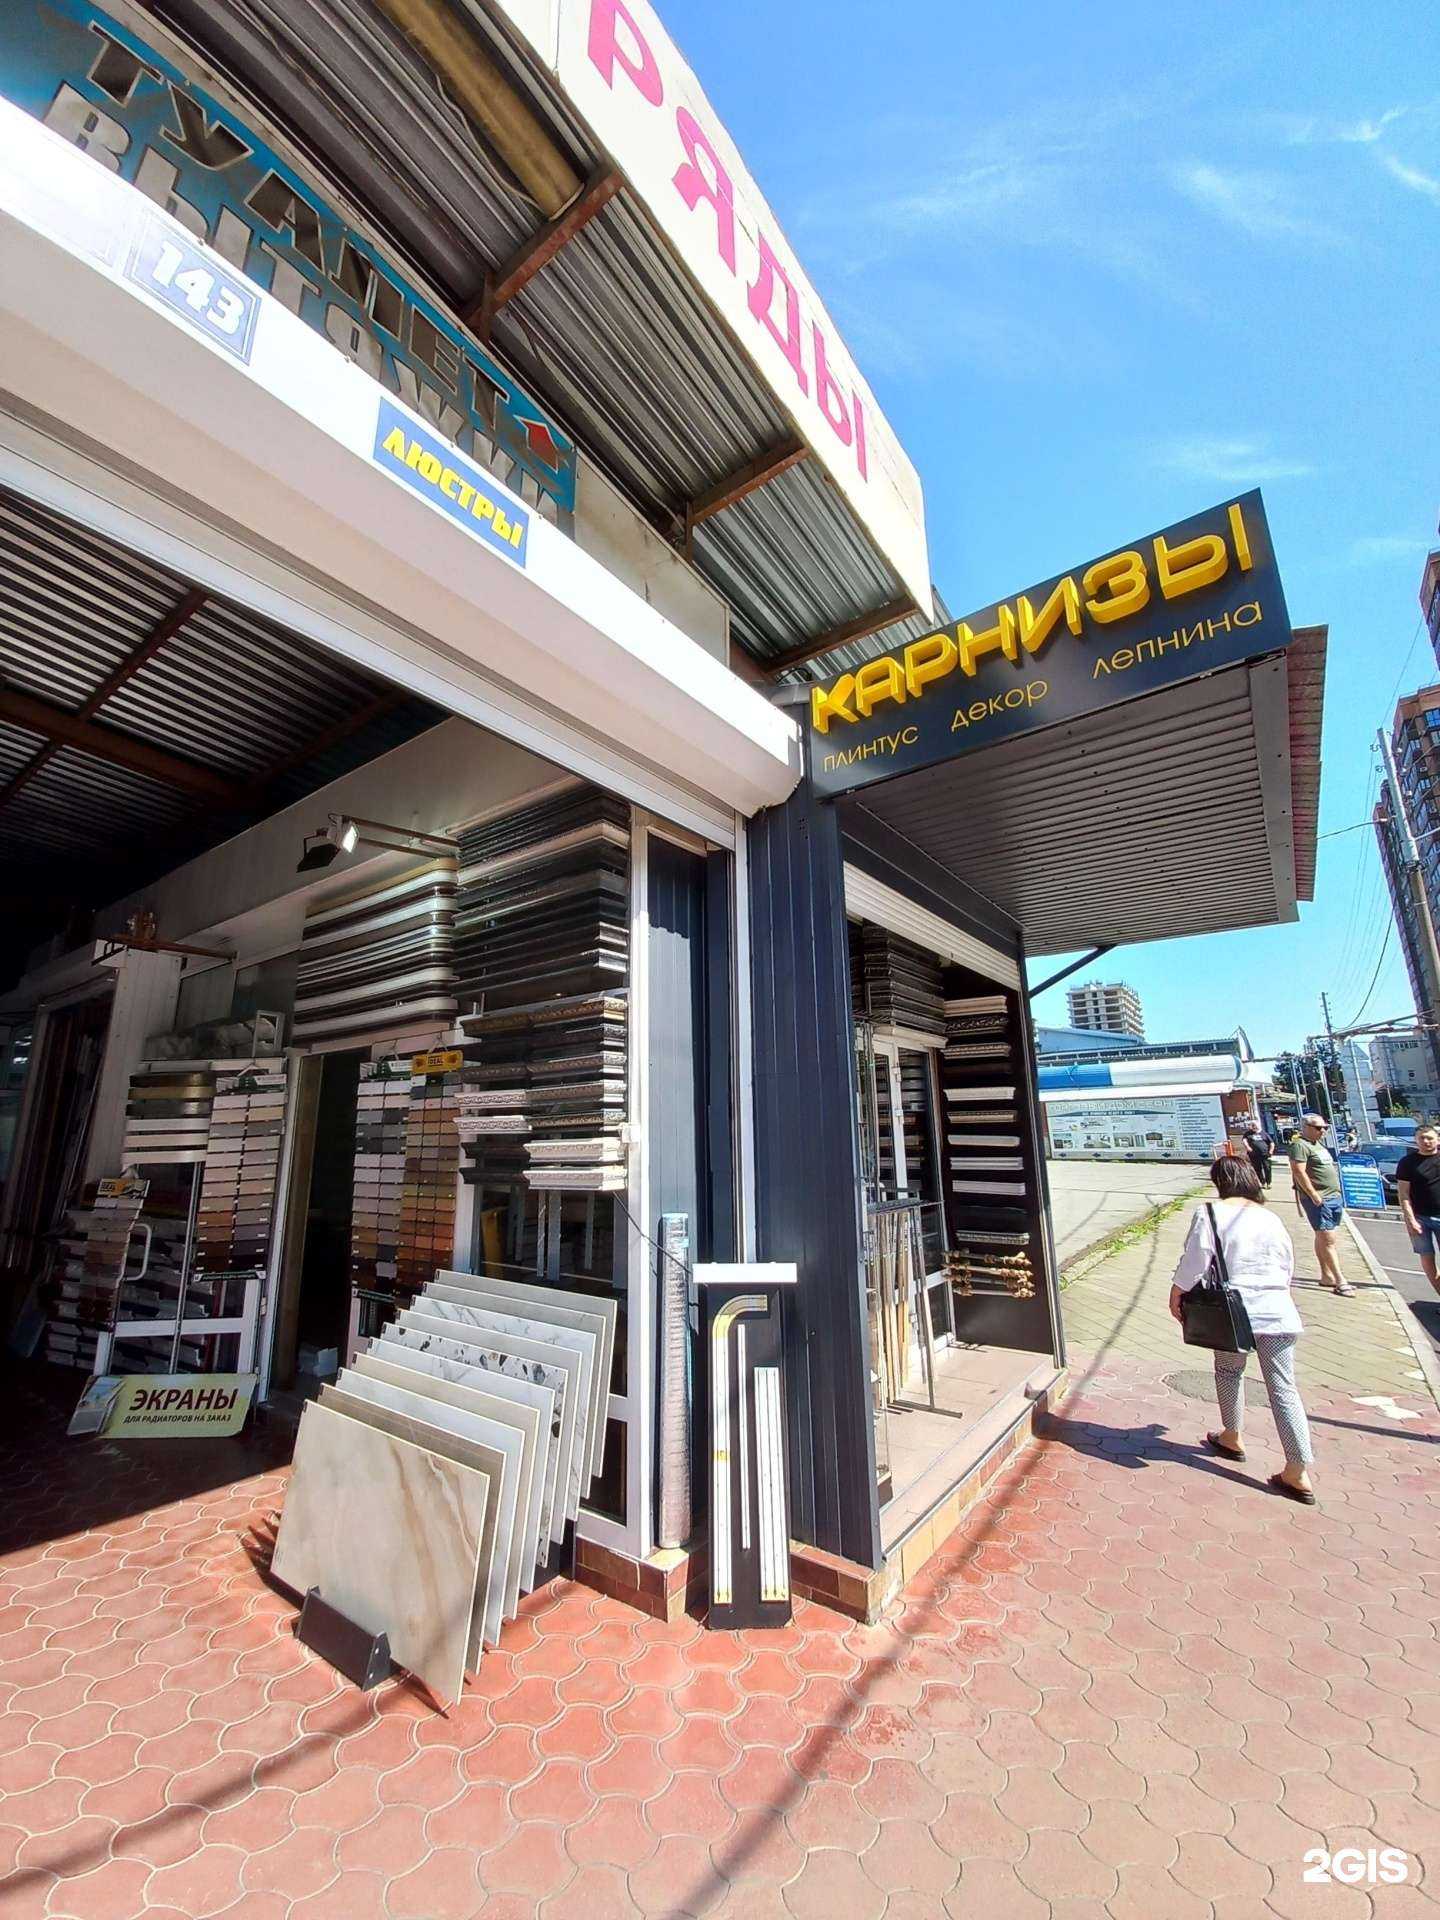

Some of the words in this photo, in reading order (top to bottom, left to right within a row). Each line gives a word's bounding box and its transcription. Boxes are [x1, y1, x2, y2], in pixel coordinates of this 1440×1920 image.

[88, 20, 511, 430] ТУАЛЕТ
[152, 239, 246, 336] 143
[588, 0, 868, 483] РЯДЫ
[382, 426, 523, 549] ЛЮСТРЫ
[811, 503, 1253, 734] КАРНИЗЫ
[823, 725, 919, 773] плинтус
[950, 679, 1049, 732] декор
[1091, 600, 1263, 679] лепнина
[123, 1415, 141, 1424] ДЛЯ
[142, 1414, 193, 1424] РАДИАТОРОВ
[194, 1414, 205, 1423] НА
[206, 1414, 231, 1423] ЗАКАЗ
[129, 1388, 239, 1411] ЭКРАНЫ
